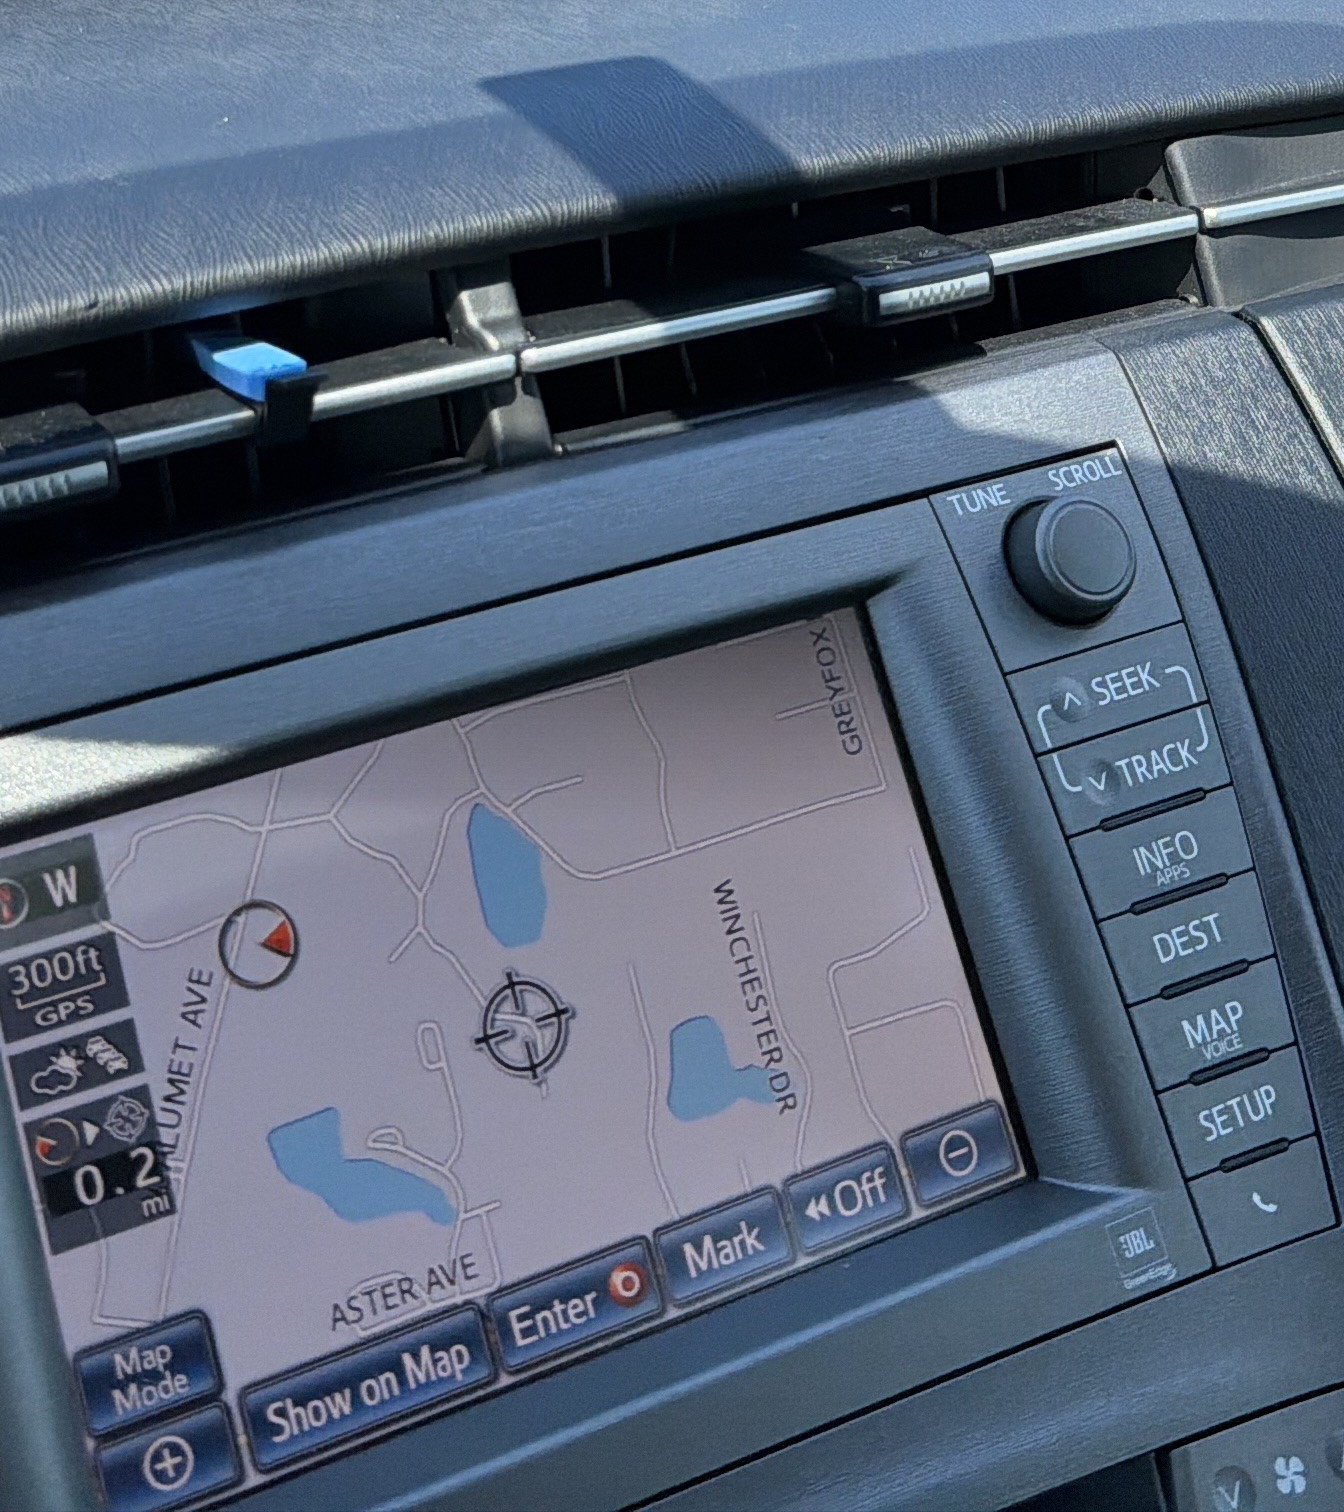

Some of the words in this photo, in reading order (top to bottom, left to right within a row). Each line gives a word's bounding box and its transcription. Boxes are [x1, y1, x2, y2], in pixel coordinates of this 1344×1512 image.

[1048, 455, 1123, 491] SCROLL
[946, 483, 1011, 517] TUNE
[809, 626, 863, 756] GREYFOX
[1091, 662, 1160, 707] SEEK
[1115, 738, 1198, 788] TRACK
[1132, 830, 1199, 877] INFO
[1156, 863, 1190, 887] APPS
[42, 865, 78, 908] W
[1152, 913, 1224, 964] DEST
[8, 945, 104, 997] 300ft
[35, 995, 95, 1027] GPS
[180, 966, 214, 1030] AVE
[712, 878, 784, 1076] WINCHESTER
[768, 1071, 798, 1116] DR
[1181, 1001, 1244, 1050] MAP
[1200, 1032, 1244, 1061] VOICE
[1199, 1084, 1277, 1142] SETUP
[74, 1146, 161, 1206] 0.2
[832, 1166, 889, 1218] Off
[140, 1190, 172, 1219] mi
[682, 1221, 766, 1278] Mark
[1119, 1227, 1156, 1259] JBL
[330, 1282, 419, 1332] ASTER
[425, 1254, 480, 1296] AVE
[508, 1289, 598, 1347] Enter
[114, 1342, 172, 1381] Map
[111, 1370, 191, 1416] Mode
[266, 1393, 353, 1443] Show
[358, 1373, 399, 1408] on
[403, 1342, 472, 1389] Map
